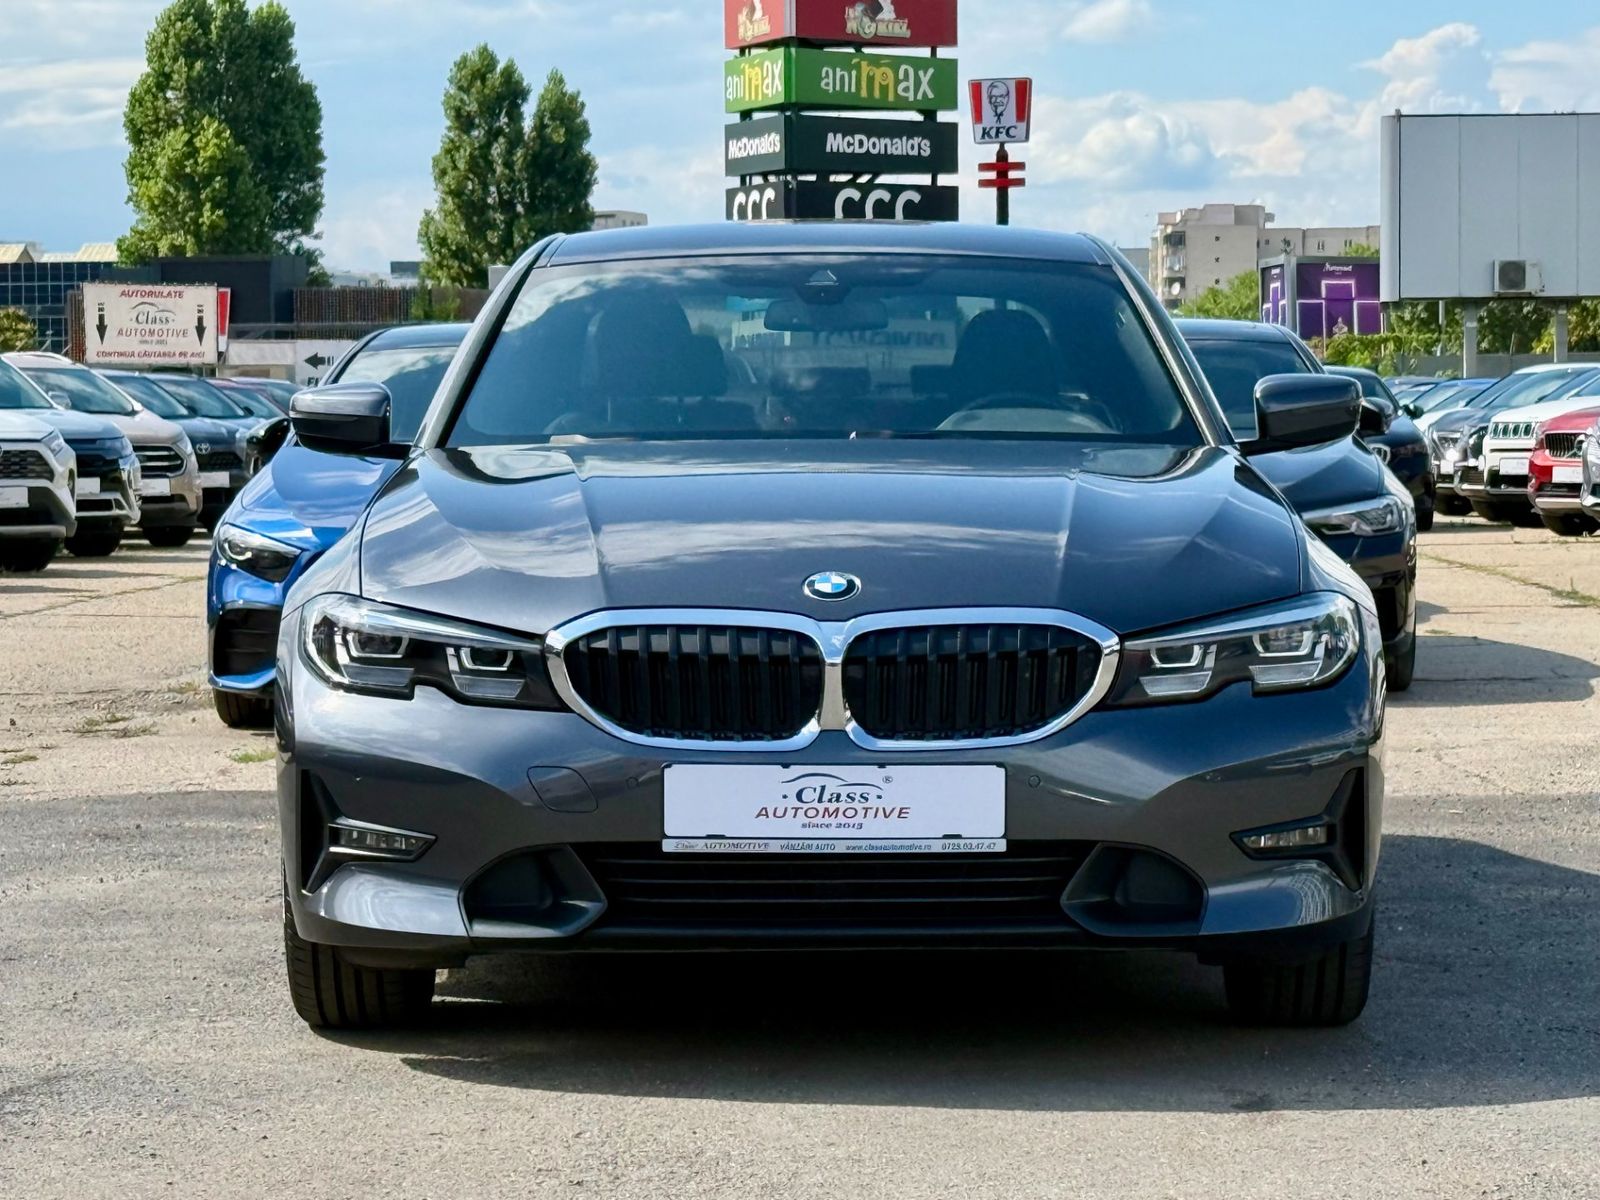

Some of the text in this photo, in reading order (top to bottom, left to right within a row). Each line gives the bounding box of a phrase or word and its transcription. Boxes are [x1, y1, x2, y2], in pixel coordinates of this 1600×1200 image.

[726, 60, 782, 101] animax
[820, 59, 935, 102] animax
[980, 125, 1018, 140] KFC
[728, 132, 781, 160] McDonald's
[826, 132, 931, 157] McDonald's
[119, 289, 185, 299] AUTORULATE
[135, 310, 170, 325] Class
[116, 328, 189, 338] AUTOMOTIVE
[795, 785, 870, 804] Class
[755, 807, 911, 819] AUTOMOTIVE
